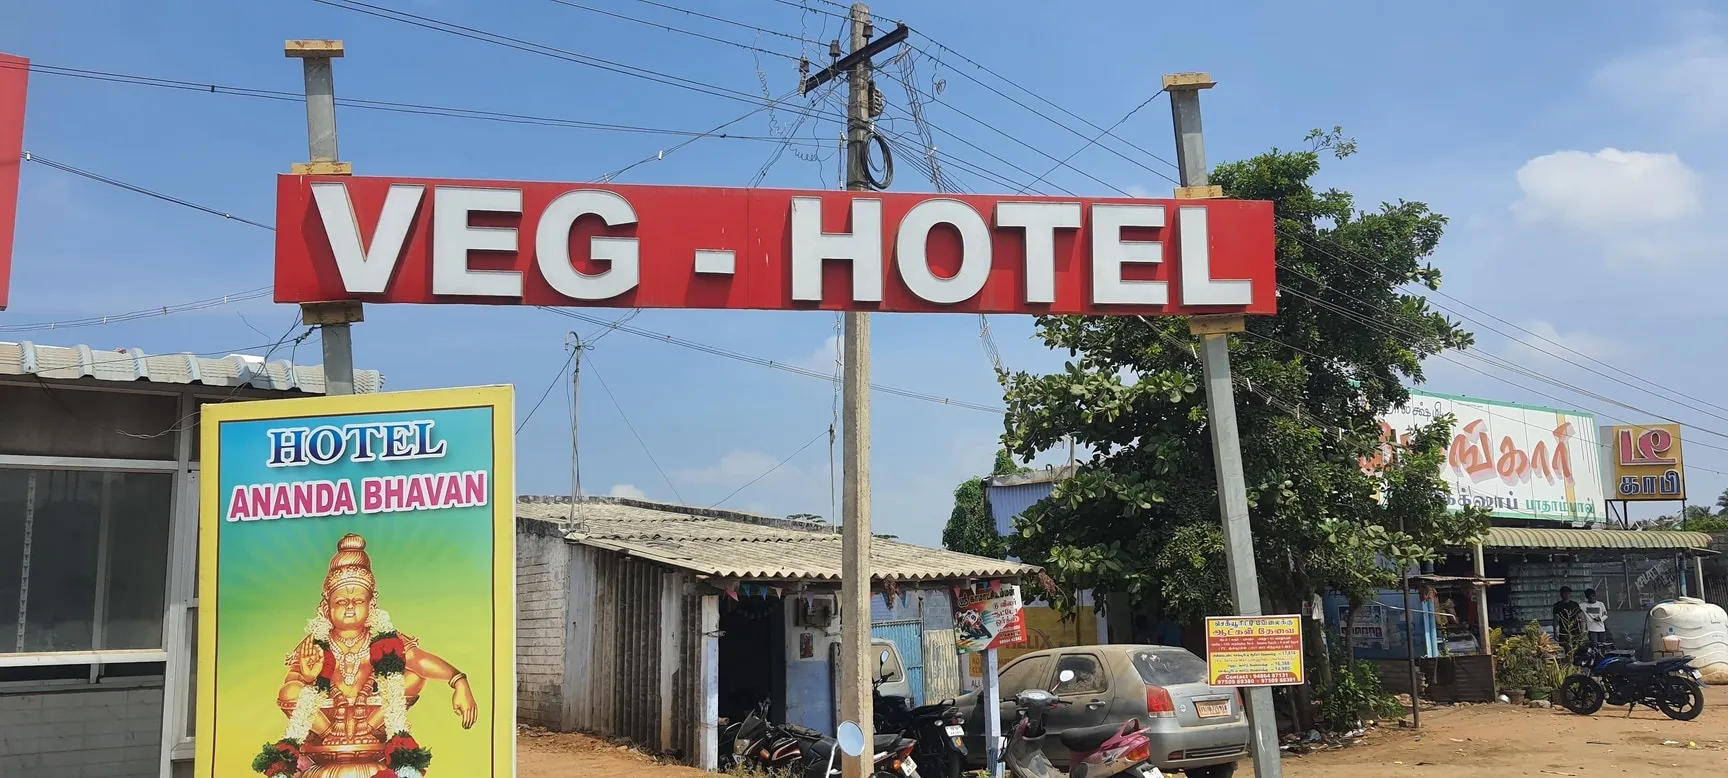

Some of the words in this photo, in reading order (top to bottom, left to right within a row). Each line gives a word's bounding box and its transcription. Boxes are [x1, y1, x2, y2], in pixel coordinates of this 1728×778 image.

[310, 181, 639, 300] VEG
[790, 196, 1253, 307] HOTEL
[267, 421, 446, 467] HOTEL
[1619, 428, 1677, 465] டீ
[228, 480, 356, 520] ANANDA
[363, 471, 486, 512] BHAVAN
[1620, 469, 1681, 495] காபி
[1212, 626, 1254, 636] ஆட்கள்
[1258, 627, 1295, 635] தேவை
